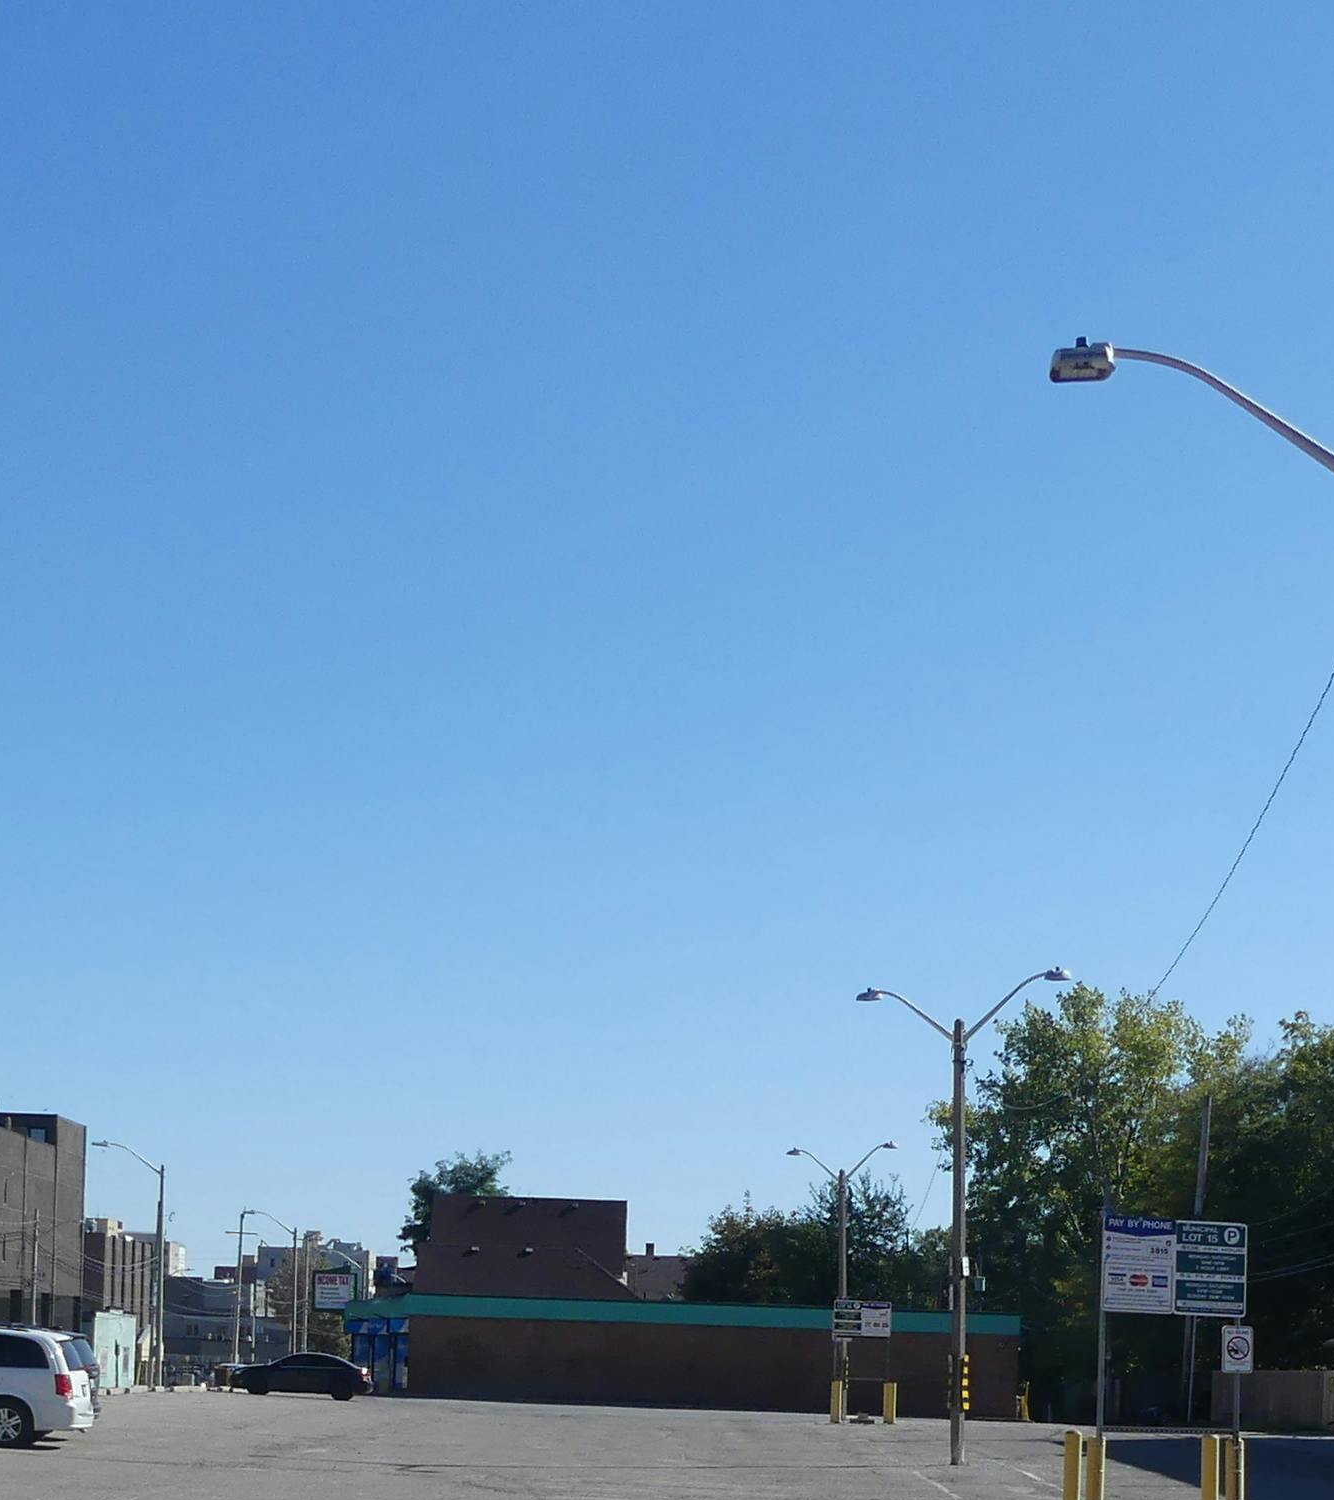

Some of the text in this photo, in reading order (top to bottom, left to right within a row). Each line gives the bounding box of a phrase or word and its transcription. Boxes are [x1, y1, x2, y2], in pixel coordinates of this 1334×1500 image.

[1108, 1218, 1172, 1230] PAY BY PHONE
[1182, 1225, 1218, 1233] MUNICIPAL
[1182, 1233, 1218, 1243] LOT 15
[317, 1276, 348, 1285] INCOME TAX
